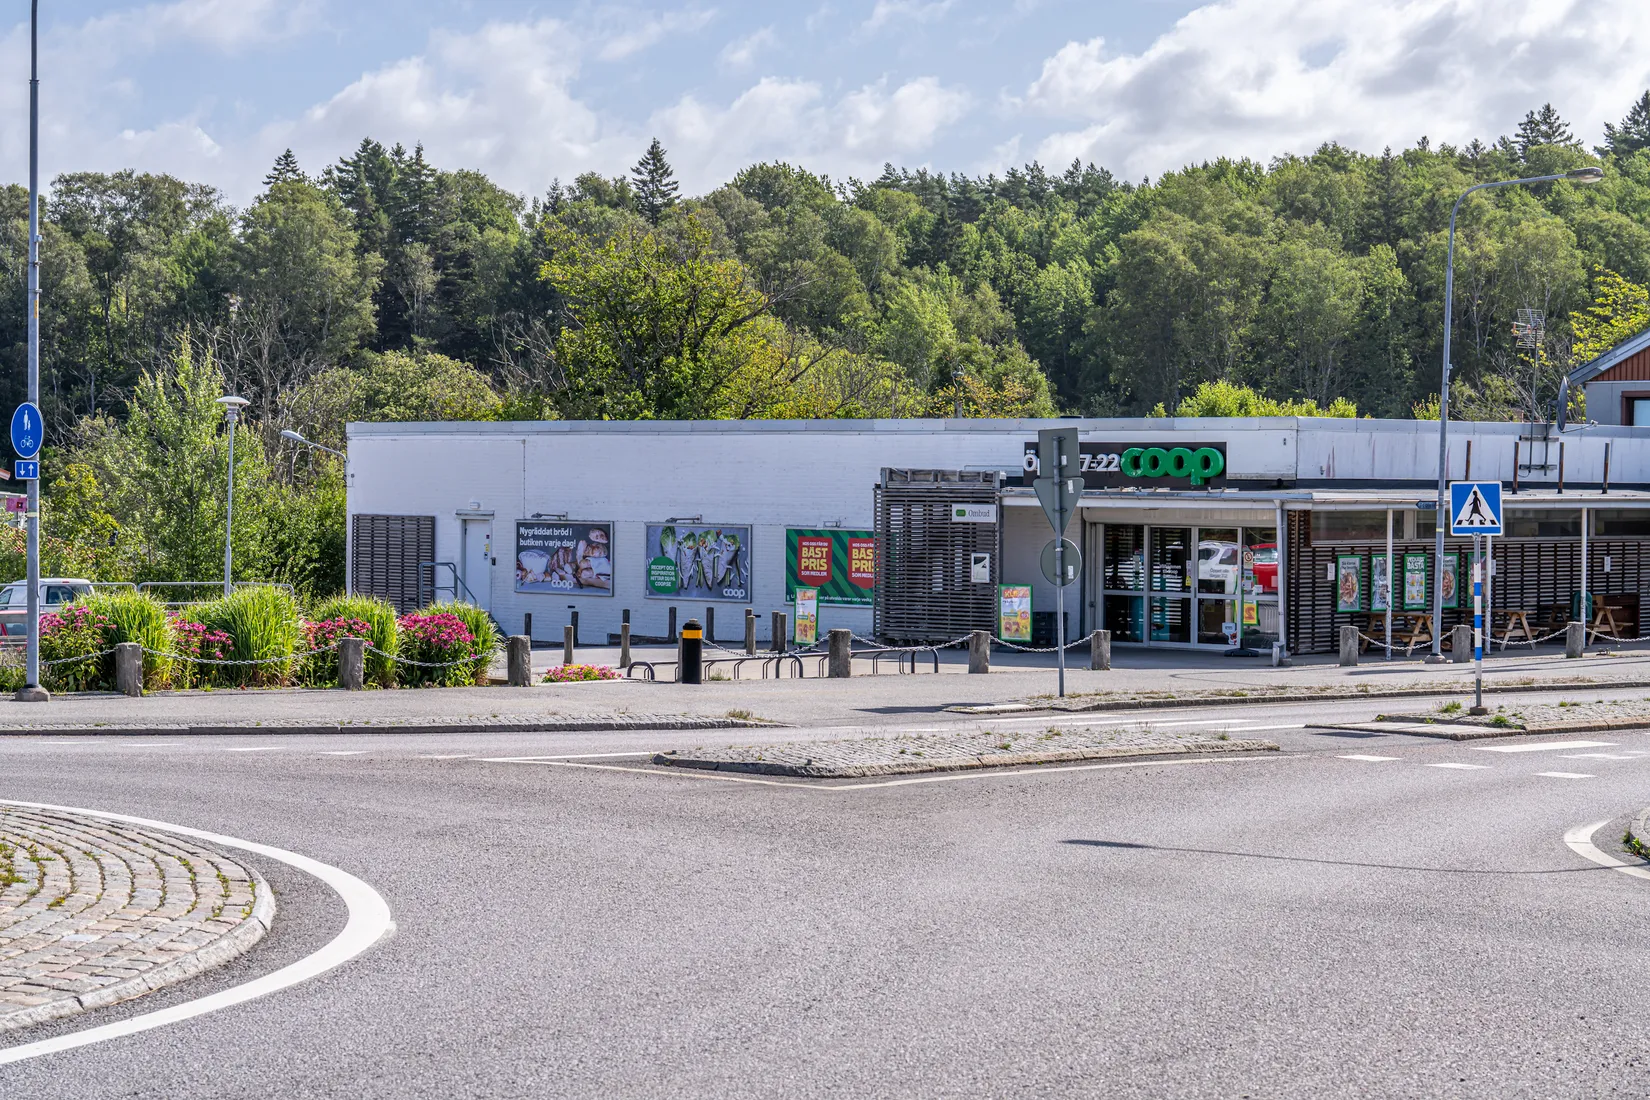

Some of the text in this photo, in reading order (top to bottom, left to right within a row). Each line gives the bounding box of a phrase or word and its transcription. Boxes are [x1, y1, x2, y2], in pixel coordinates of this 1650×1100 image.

[1120, 447, 1224, 485] coop
[968, 509, 990, 518] Ombud
[519, 526, 573, 536] Nygräddat bröd i
[519, 537, 577, 550] butiken varje dag!
[802, 547, 828, 558] BÄST
[852, 547, 874, 559] BÄS
[801, 558, 828, 570] PRIS
[551, 579, 573, 590] coop
[722, 588, 746, 598] coop
